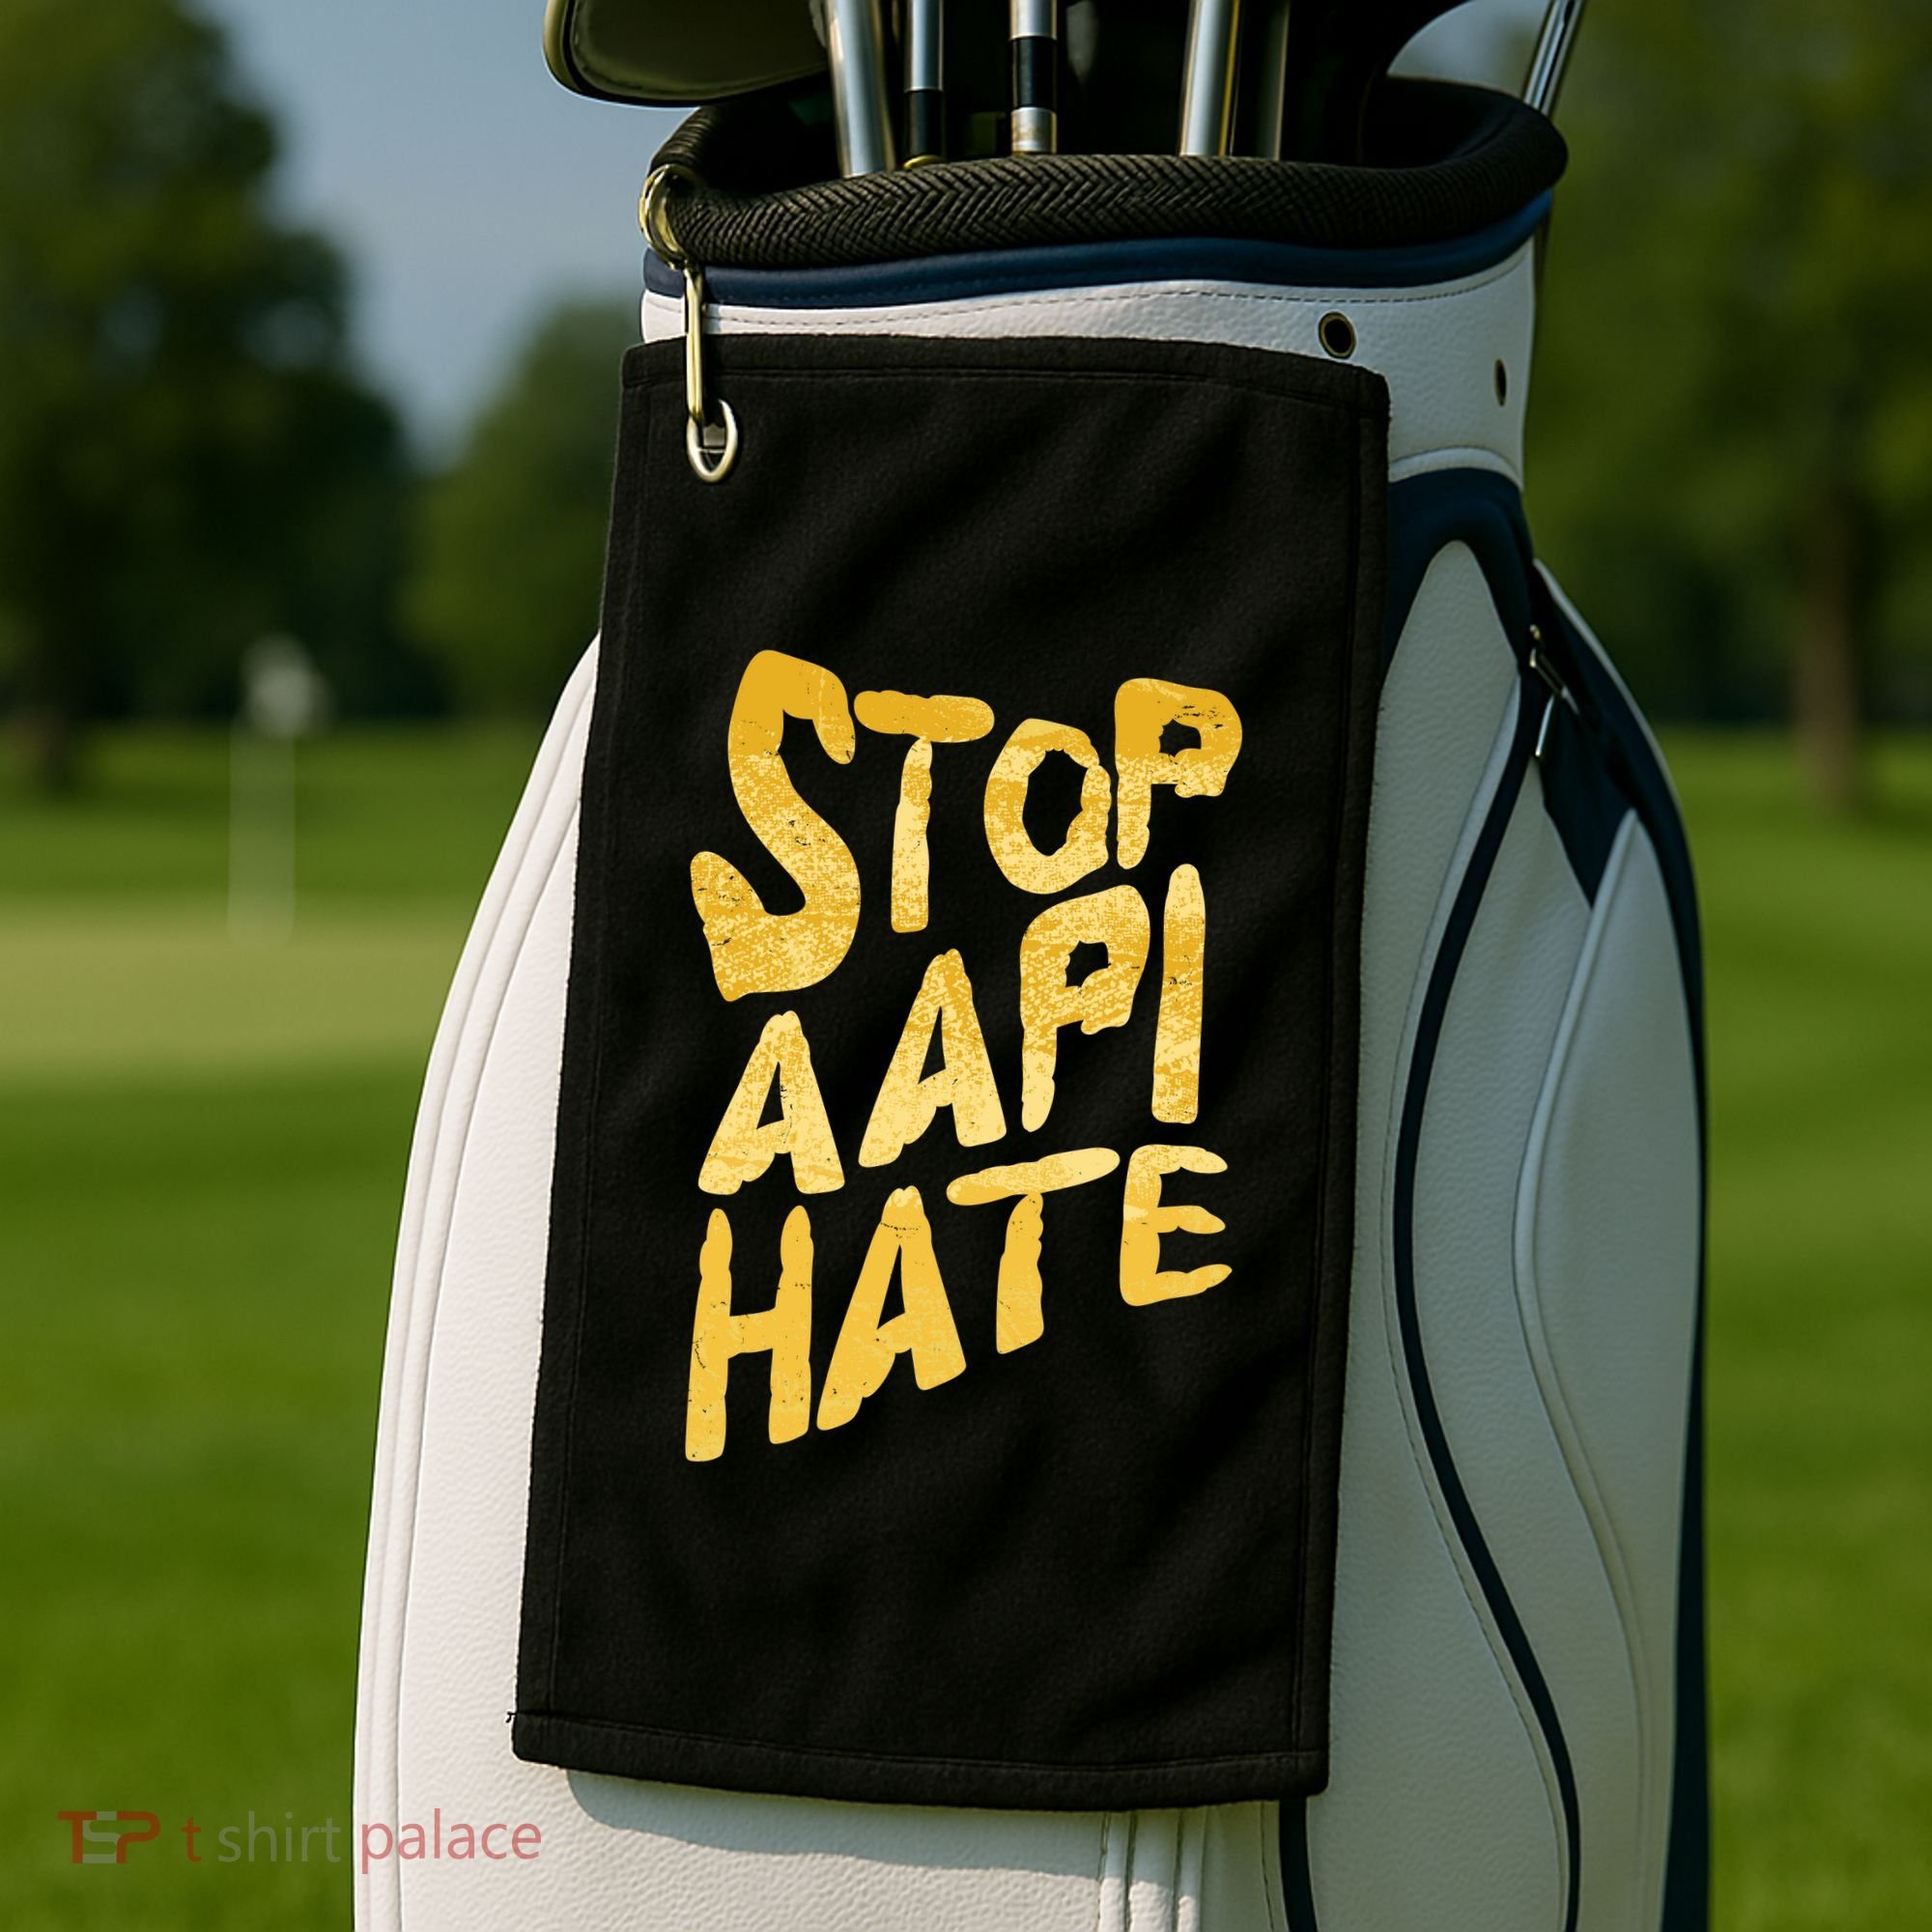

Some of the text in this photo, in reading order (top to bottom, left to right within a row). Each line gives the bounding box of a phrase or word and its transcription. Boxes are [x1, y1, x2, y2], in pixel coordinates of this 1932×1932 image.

[690, 650, 1242, 1001] STOP
[698, 864, 1206, 1195] AAPI
[686, 1145, 1232, 1462] HATE
